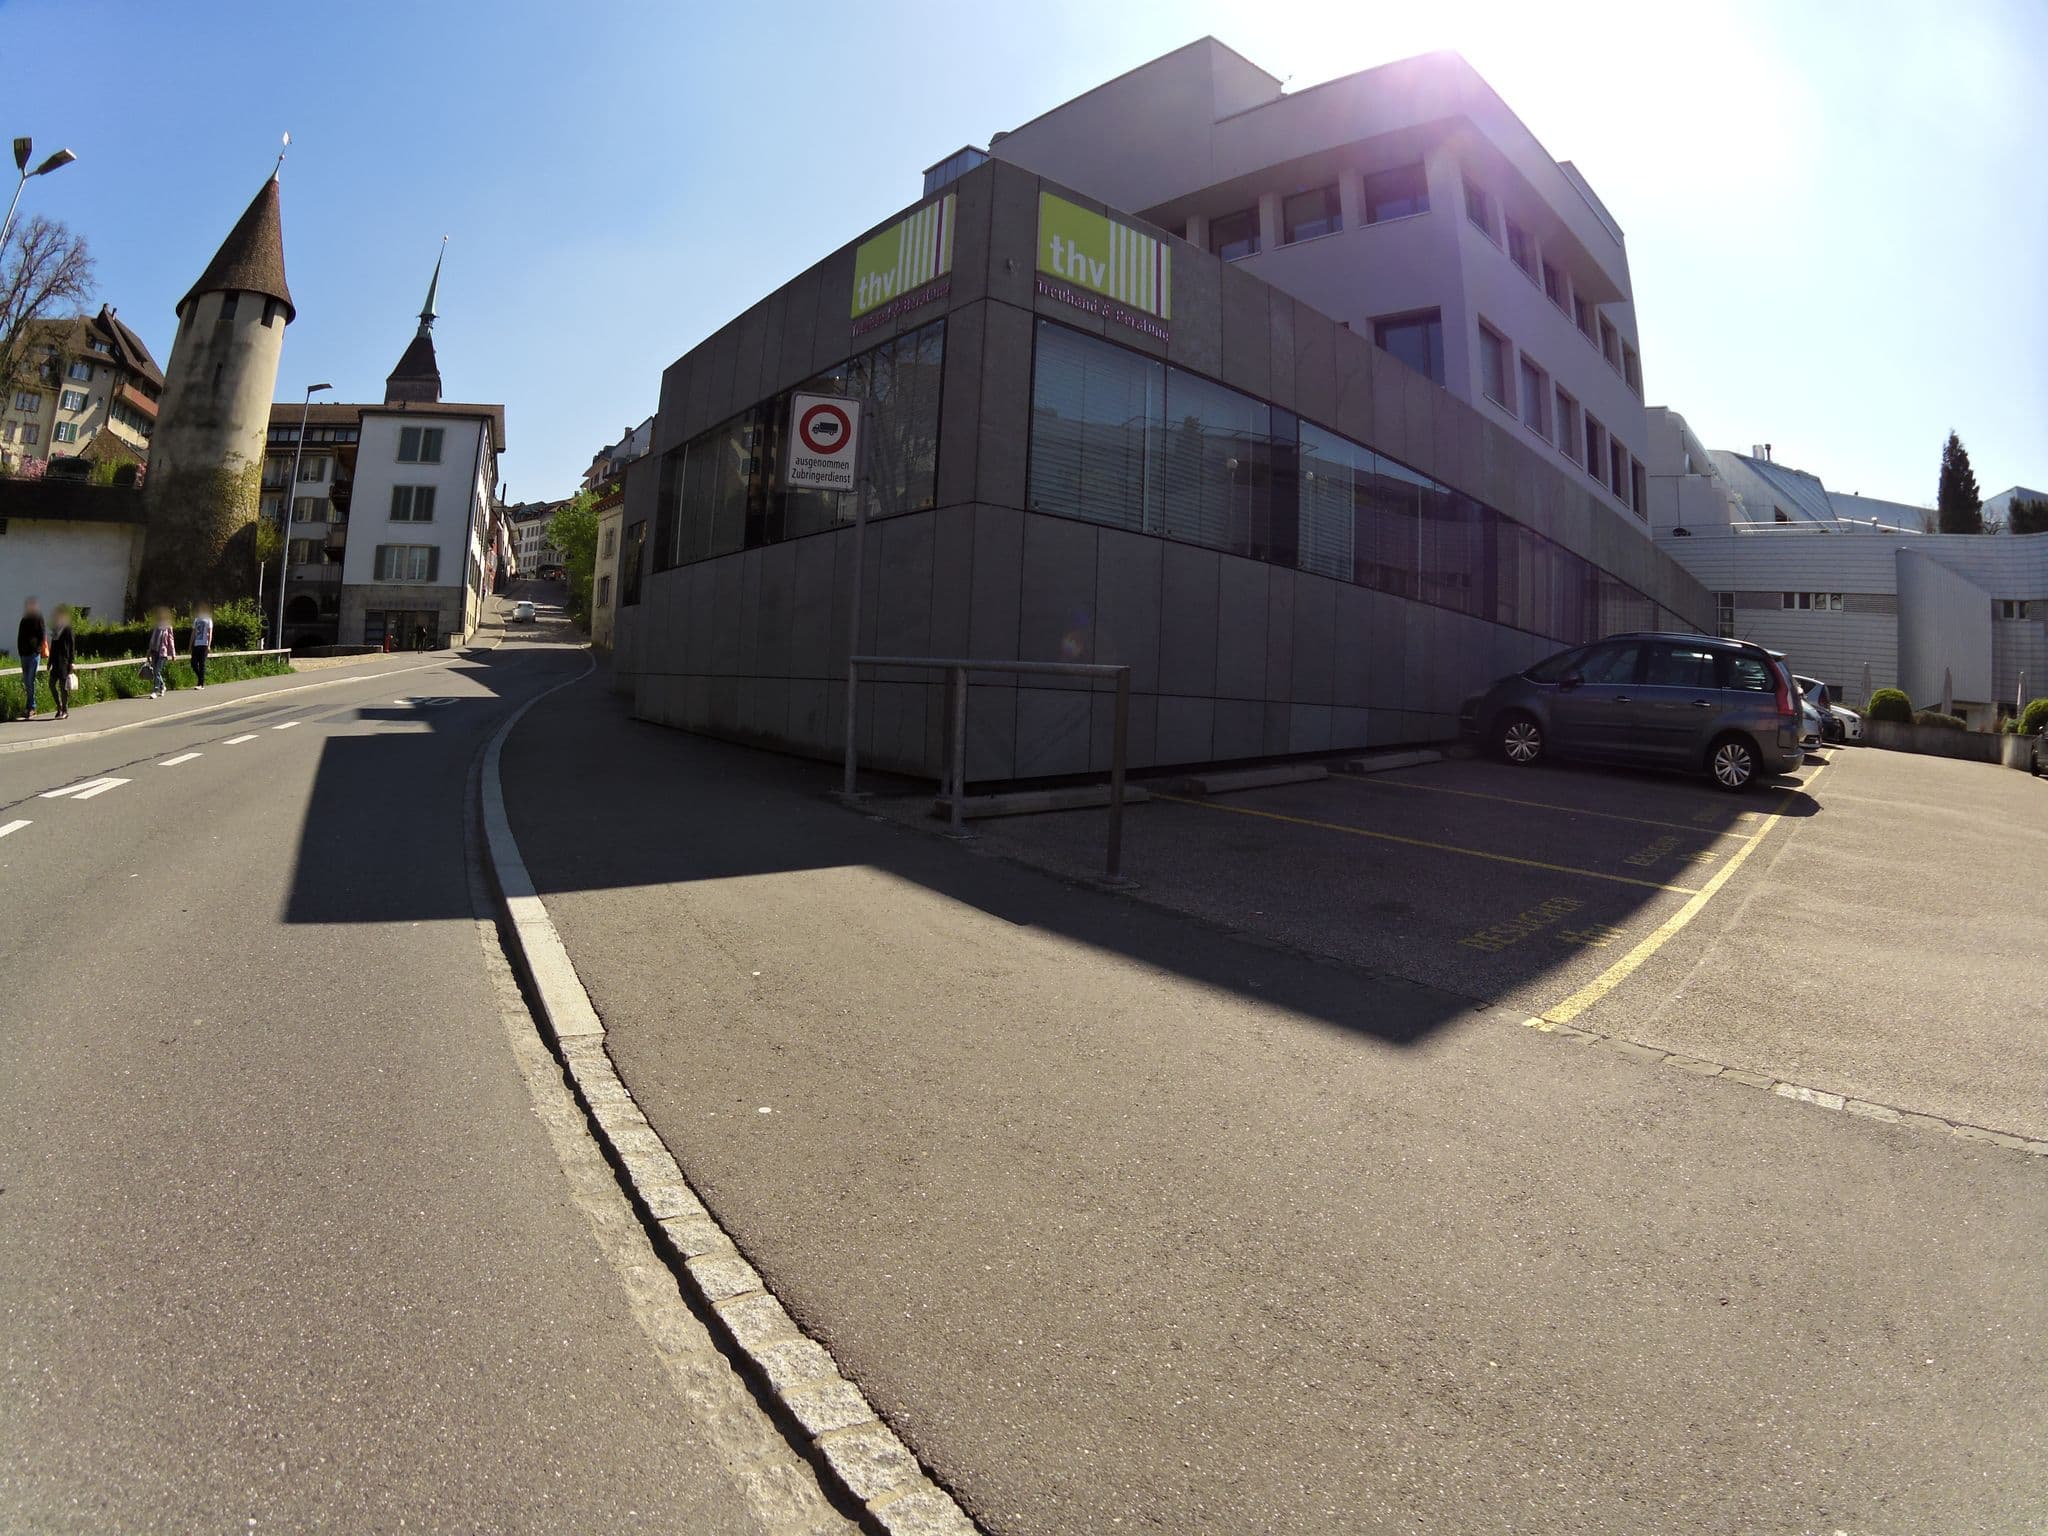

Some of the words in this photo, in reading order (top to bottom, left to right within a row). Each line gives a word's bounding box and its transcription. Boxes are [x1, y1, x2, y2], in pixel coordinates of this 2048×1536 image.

[1050, 234, 1106, 288] thv
[858, 267, 896, 311] thv
[1102, 303, 1112, 319] &
[795, 456, 850, 471] ausgenommen
[791, 467, 851, 484] Zubringerdienst
